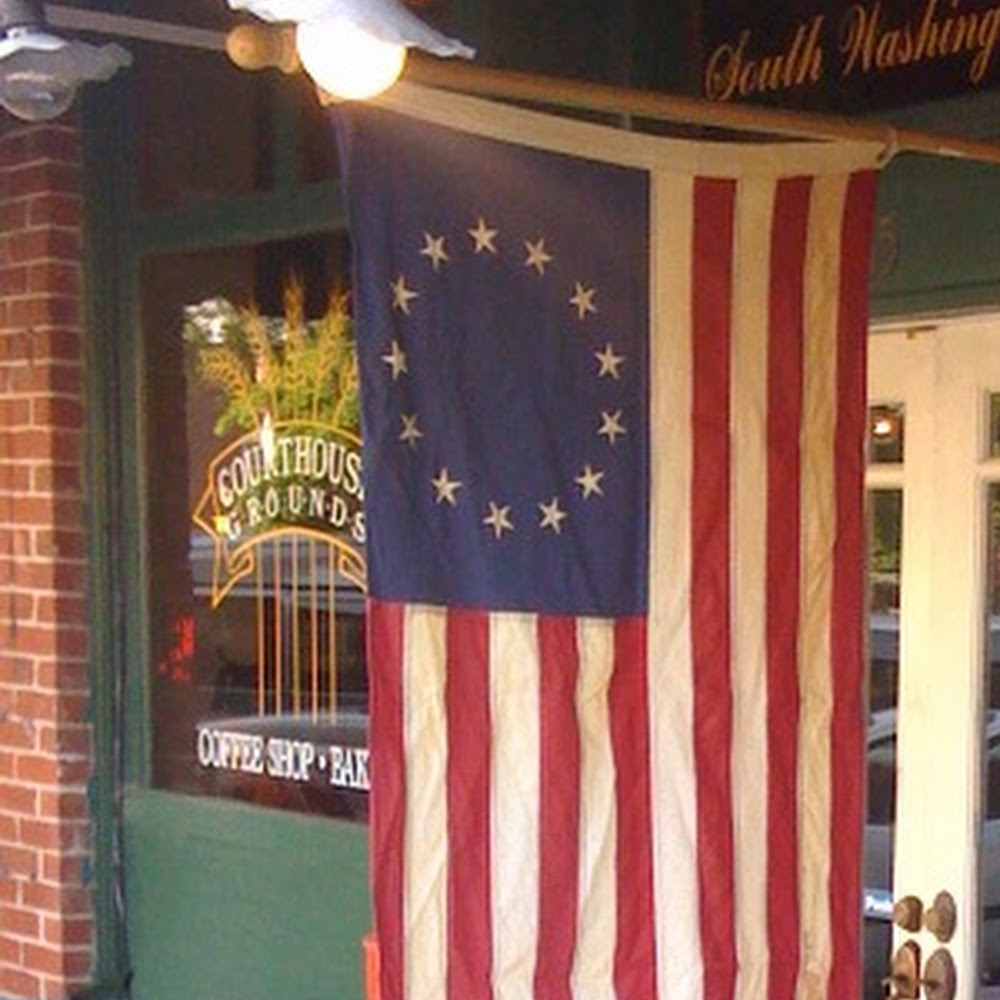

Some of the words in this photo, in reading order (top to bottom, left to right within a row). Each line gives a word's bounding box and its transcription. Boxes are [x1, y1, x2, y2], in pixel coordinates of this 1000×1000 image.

[705, 15, 824, 101] South
[217, 436, 365, 507] COURTHOUS
[266, 737, 315, 781] SHOP
